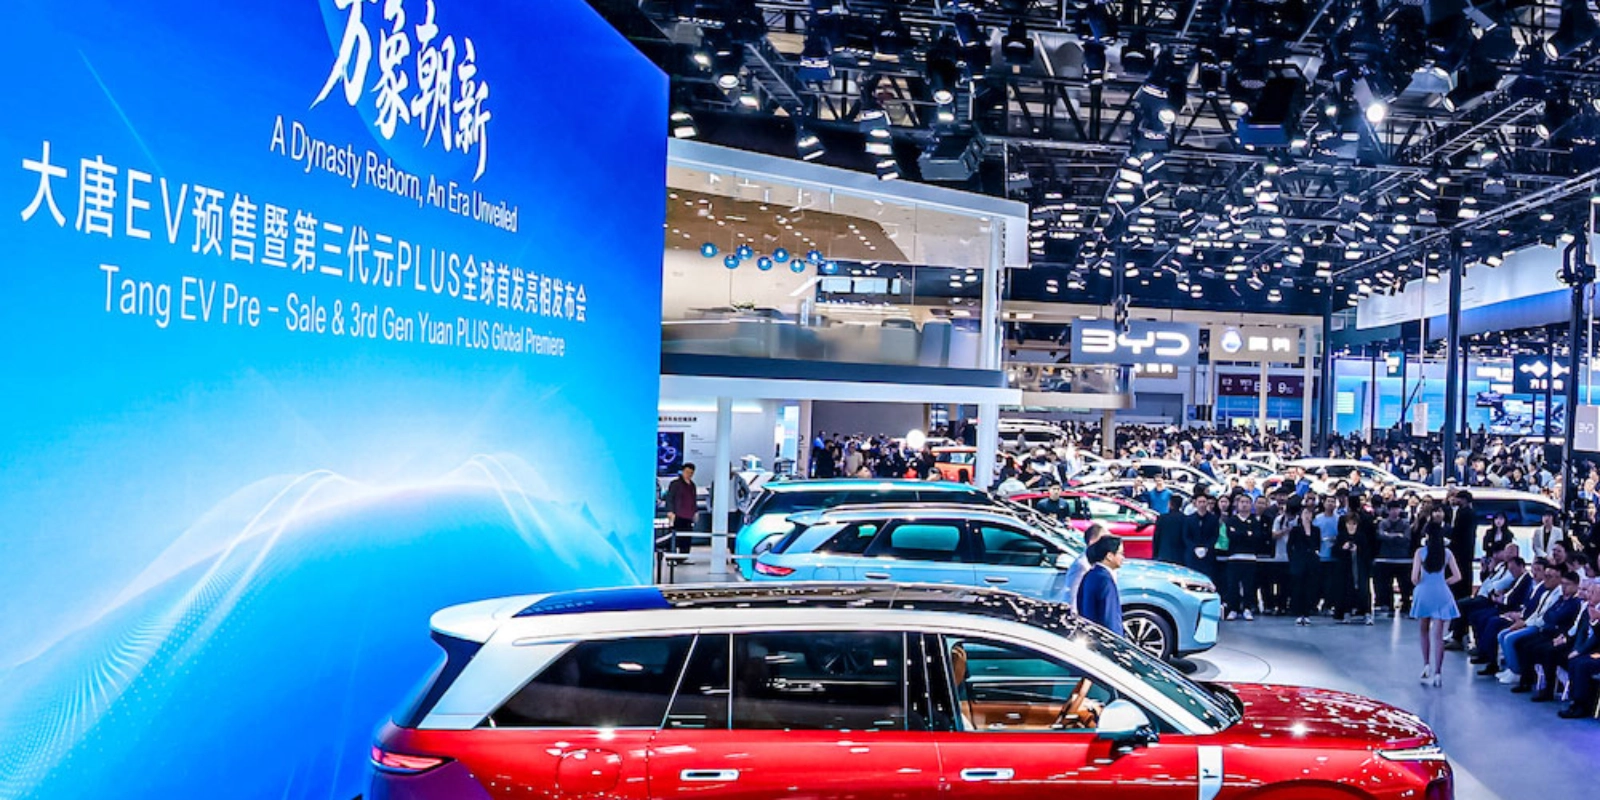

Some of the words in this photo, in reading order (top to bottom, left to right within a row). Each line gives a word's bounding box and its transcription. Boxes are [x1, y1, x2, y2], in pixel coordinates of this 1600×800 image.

[309, 0, 491, 183] 万象朝新
[20, 140, 587, 323] 大唐EV预售暨第三代元PLUS全球首发亮相发布会
[270, 115, 286, 155] A
[291, 121, 362, 188] Dynasty
[365, 150, 423, 208] Reborn,
[427, 174, 446, 209] An
[449, 181, 470, 217] Era
[473, 190, 518, 233] Unveiled
[99, 263, 171, 328] Tang
[180, 275, 217, 322] EV
[222, 282, 261, 327] Pre
[286, 291, 328, 334] Sale
[331, 299, 346, 336] &
[350, 301, 378, 339] 3rd
[382, 307, 414, 342] Gen
[418, 311, 453, 346] Yuan
[457, 316, 489, 350] PLUS
[491, 322, 524, 354] Global
[525, 327, 566, 358] Premiere
[1081, 328, 1191, 357] BYD
